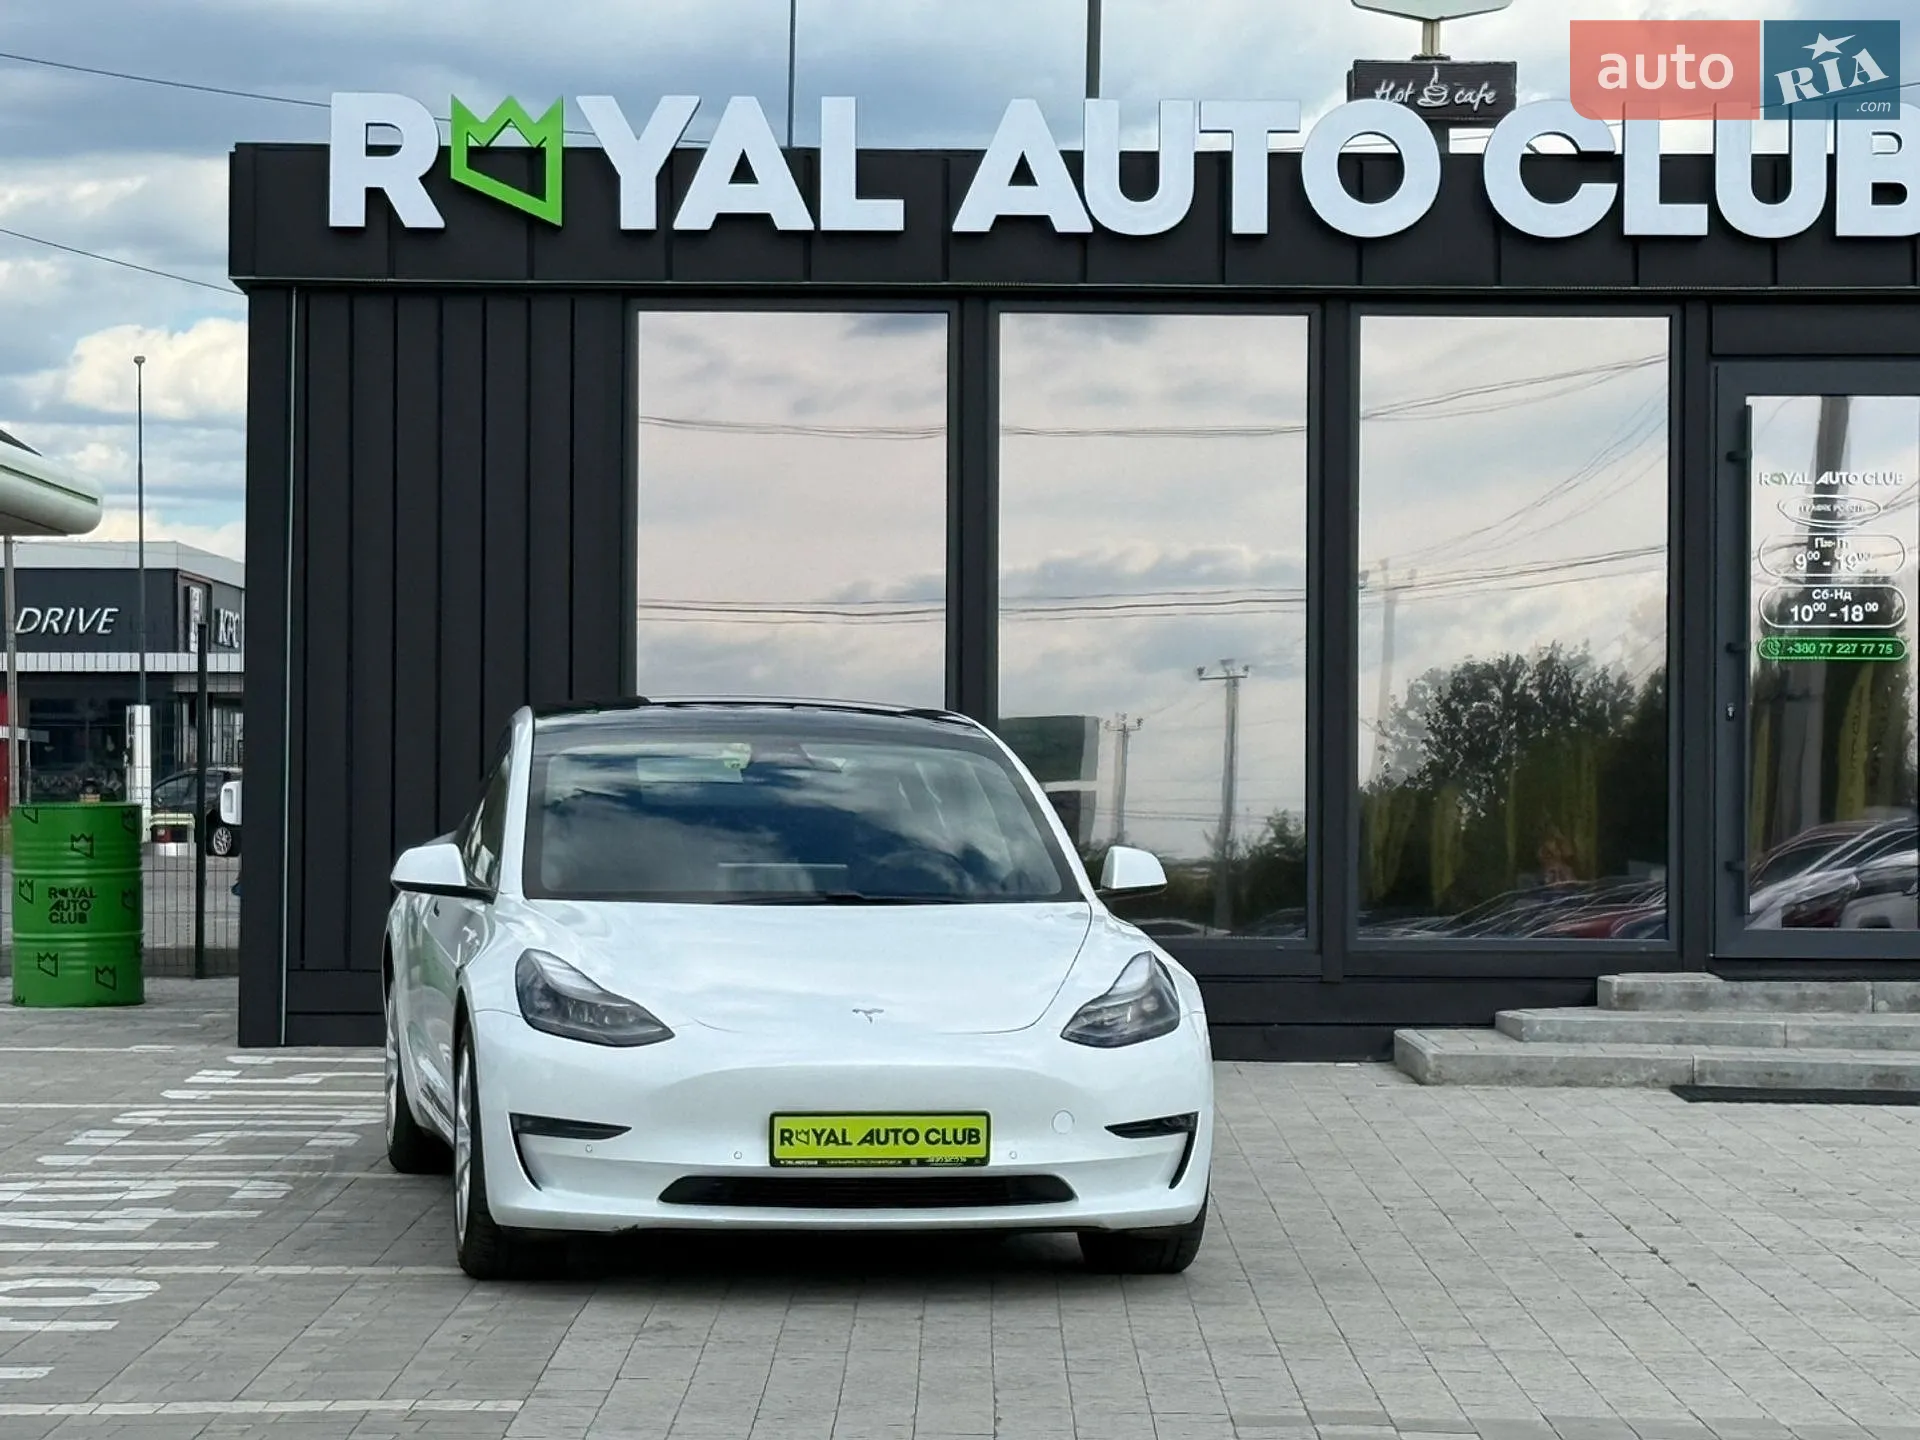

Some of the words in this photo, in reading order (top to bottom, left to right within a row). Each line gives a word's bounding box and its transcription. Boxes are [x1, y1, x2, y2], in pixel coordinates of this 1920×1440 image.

[1375, 79, 1416, 103] Hot
[1454, 81, 1497, 112] cafe
[952, 98, 1441, 238] AUTO
[1484, 98, 1920, 239] CLUB
[1816, 471, 1857, 486] AUTO
[14, 607, 119, 634] DRIVE
[49, 899, 92, 912] AUTO
[48, 911, 88, 924] CLUB
[857, 1128, 920, 1146] AUTO
[924, 1128, 981, 1146] CLUB
